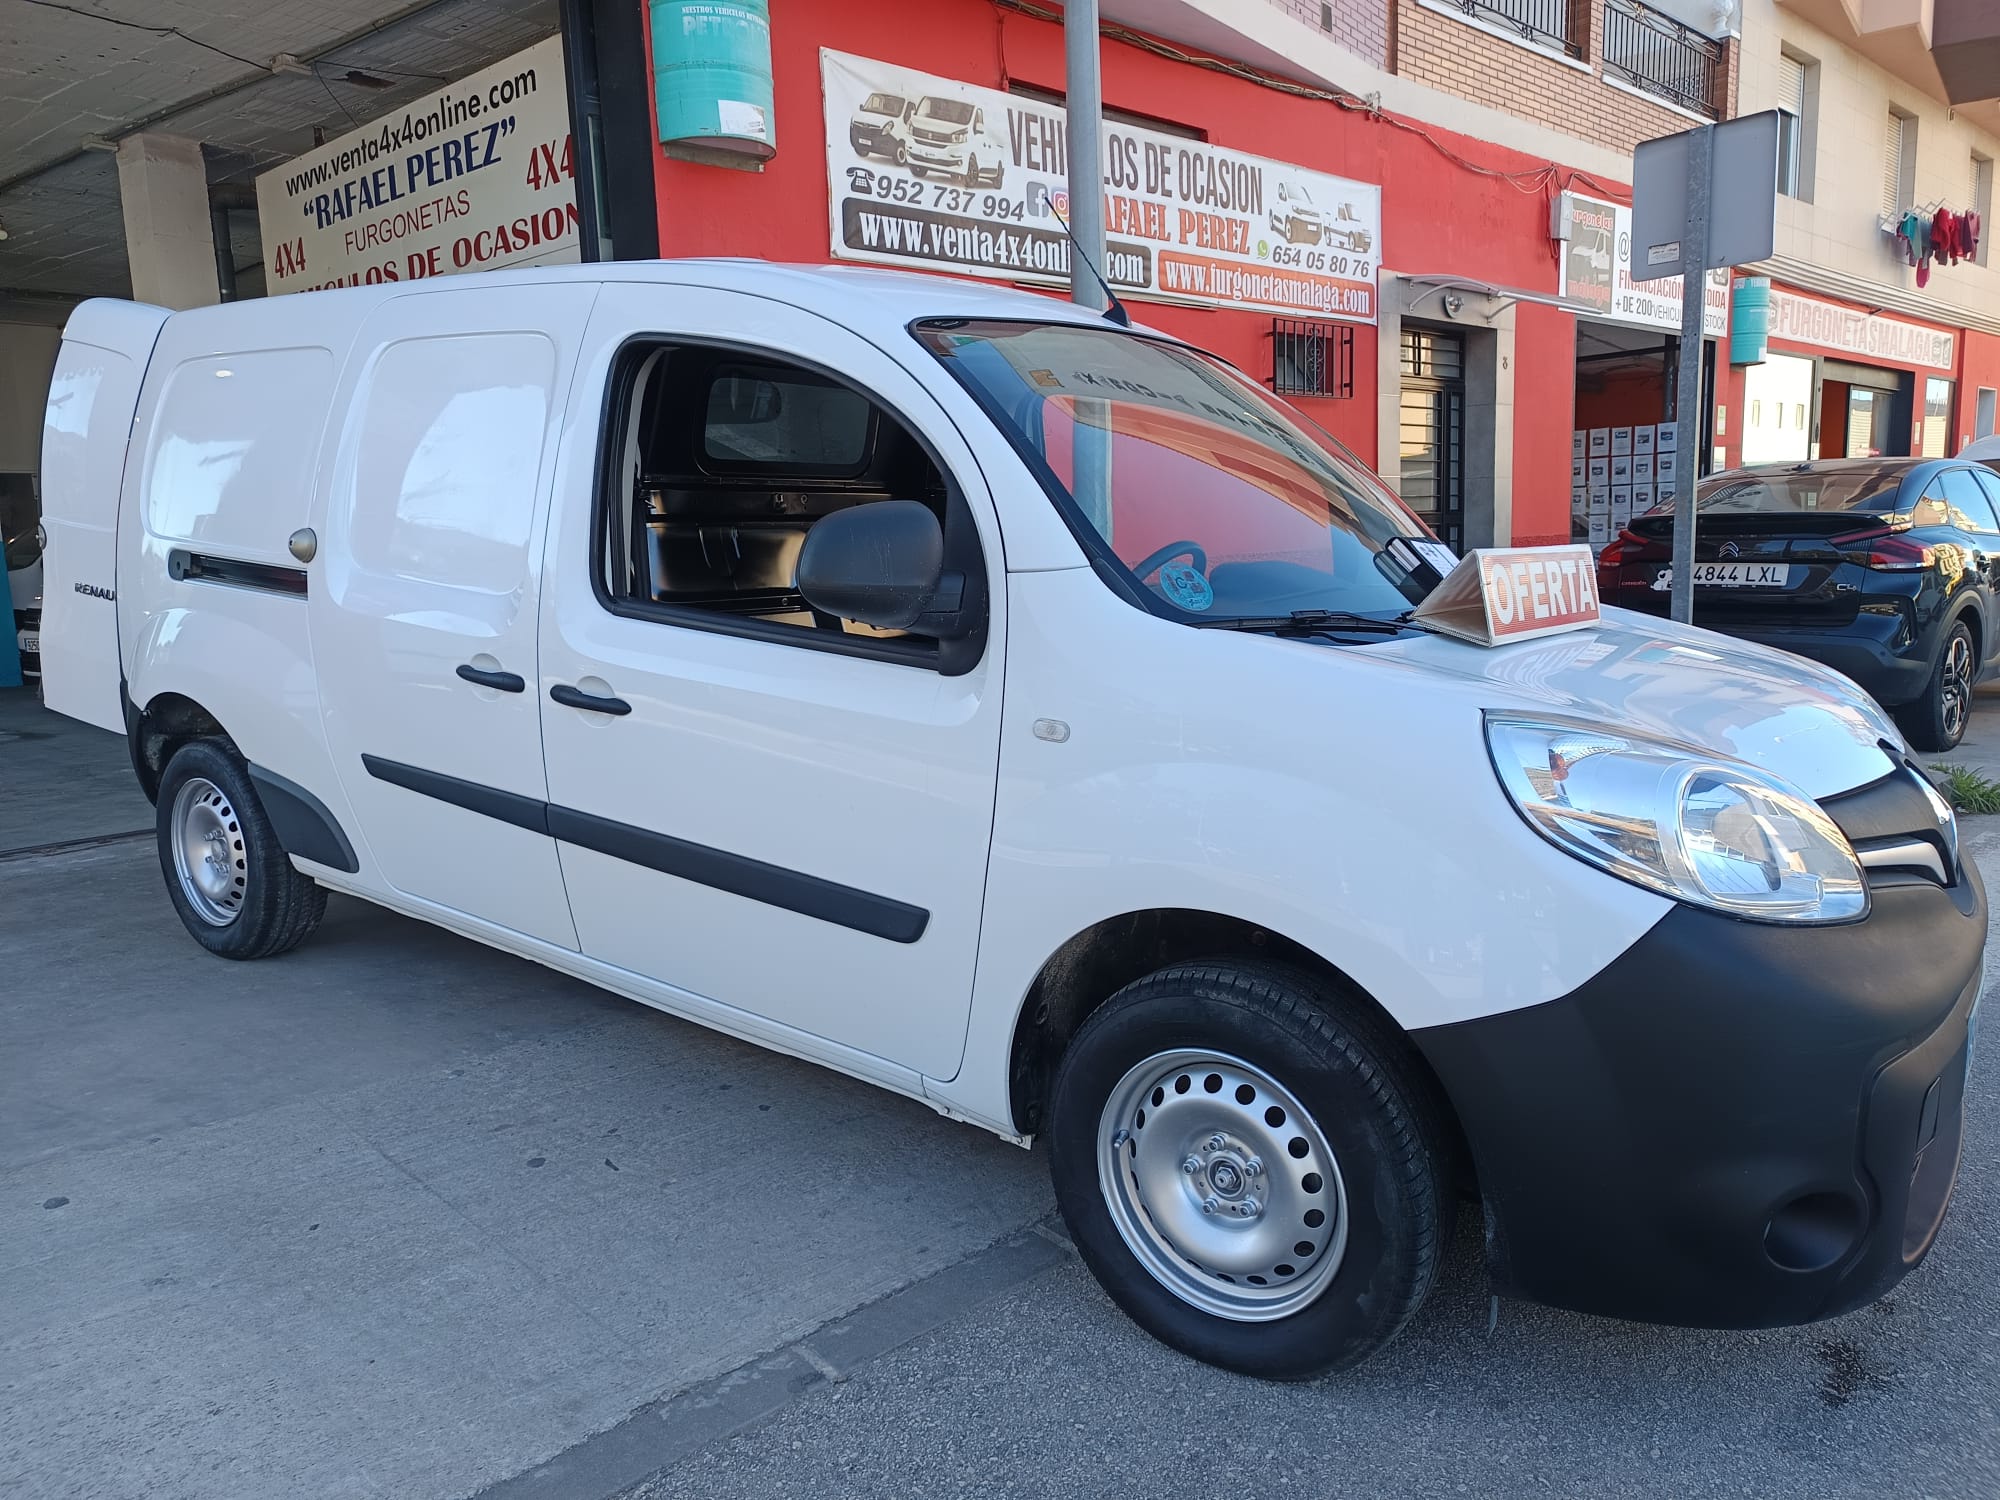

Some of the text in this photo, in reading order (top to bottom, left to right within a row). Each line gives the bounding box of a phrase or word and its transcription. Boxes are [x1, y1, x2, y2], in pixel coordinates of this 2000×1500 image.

[682, 5, 713, 14] NUESTROS
[286, 69, 537, 197] www.venta4x4online.com
[526, 134, 576, 191] 4X4
[1007, 107, 1264, 216] VEHIOS DE OCASION
[876, 175, 1025, 222] 952 737 994
[1573, 208, 1614, 231] urgonetas
[344, 190, 471, 255] FURGONETAS
[1105, 193, 1251, 255] AFAEL PEREZ
[274, 237, 306, 279] 4X4
[407, 246, 444, 281] DE
[1272, 245, 1370, 278] 654 05 80 76
[1164, 258, 1370, 314] www.furgonetasmalaga.com
[1703, 287, 1726, 310] DIDA
[1623, 296, 1634, 314] DE
[1636, 298, 1653, 317] 200
[1704, 313, 1726, 331] STOCK
[74, 583, 117, 601] RENAU
[1491, 558, 1597, 625] OFERTA
[1693, 566, 1782, 583] 4844 LXL
